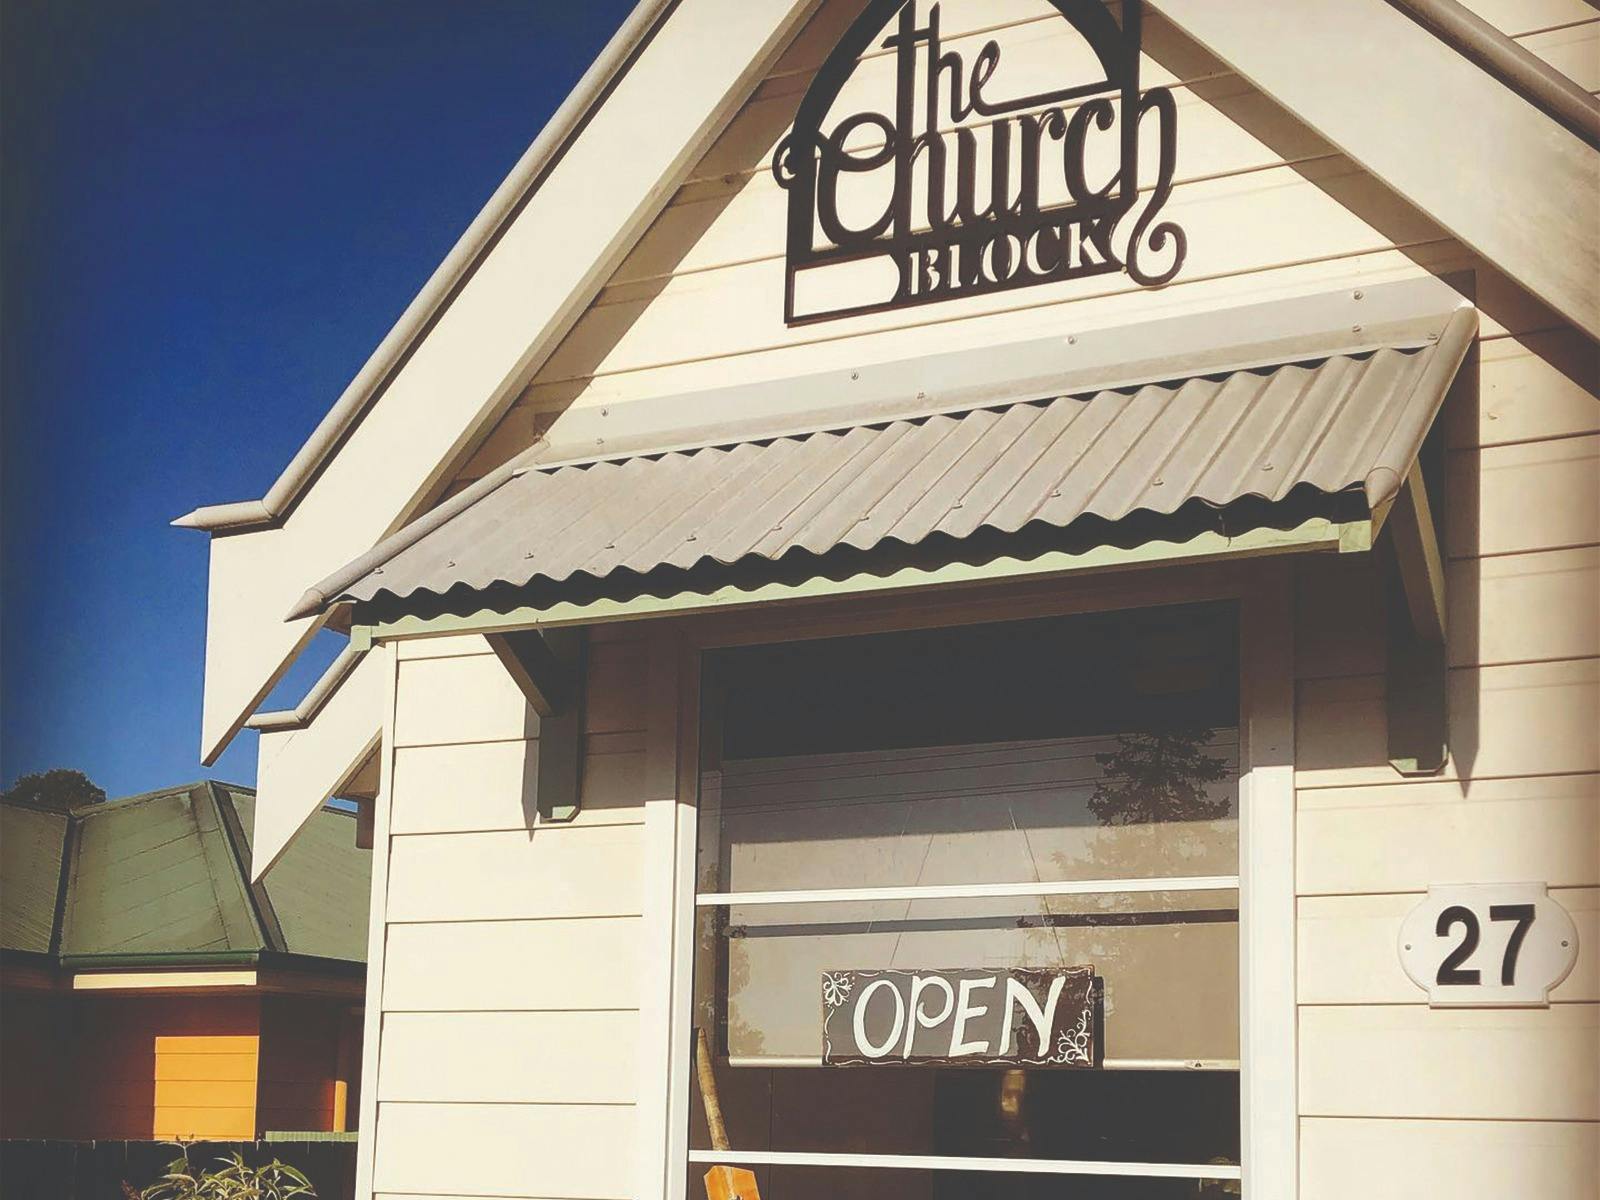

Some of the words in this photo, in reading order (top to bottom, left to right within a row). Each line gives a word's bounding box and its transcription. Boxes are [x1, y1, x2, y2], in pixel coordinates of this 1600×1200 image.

[881, 0, 1001, 126] the
[909, 215, 1108, 296] BLOCK
[1435, 903, 1536, 986] 27
[853, 975, 1066, 1059] OPEN
